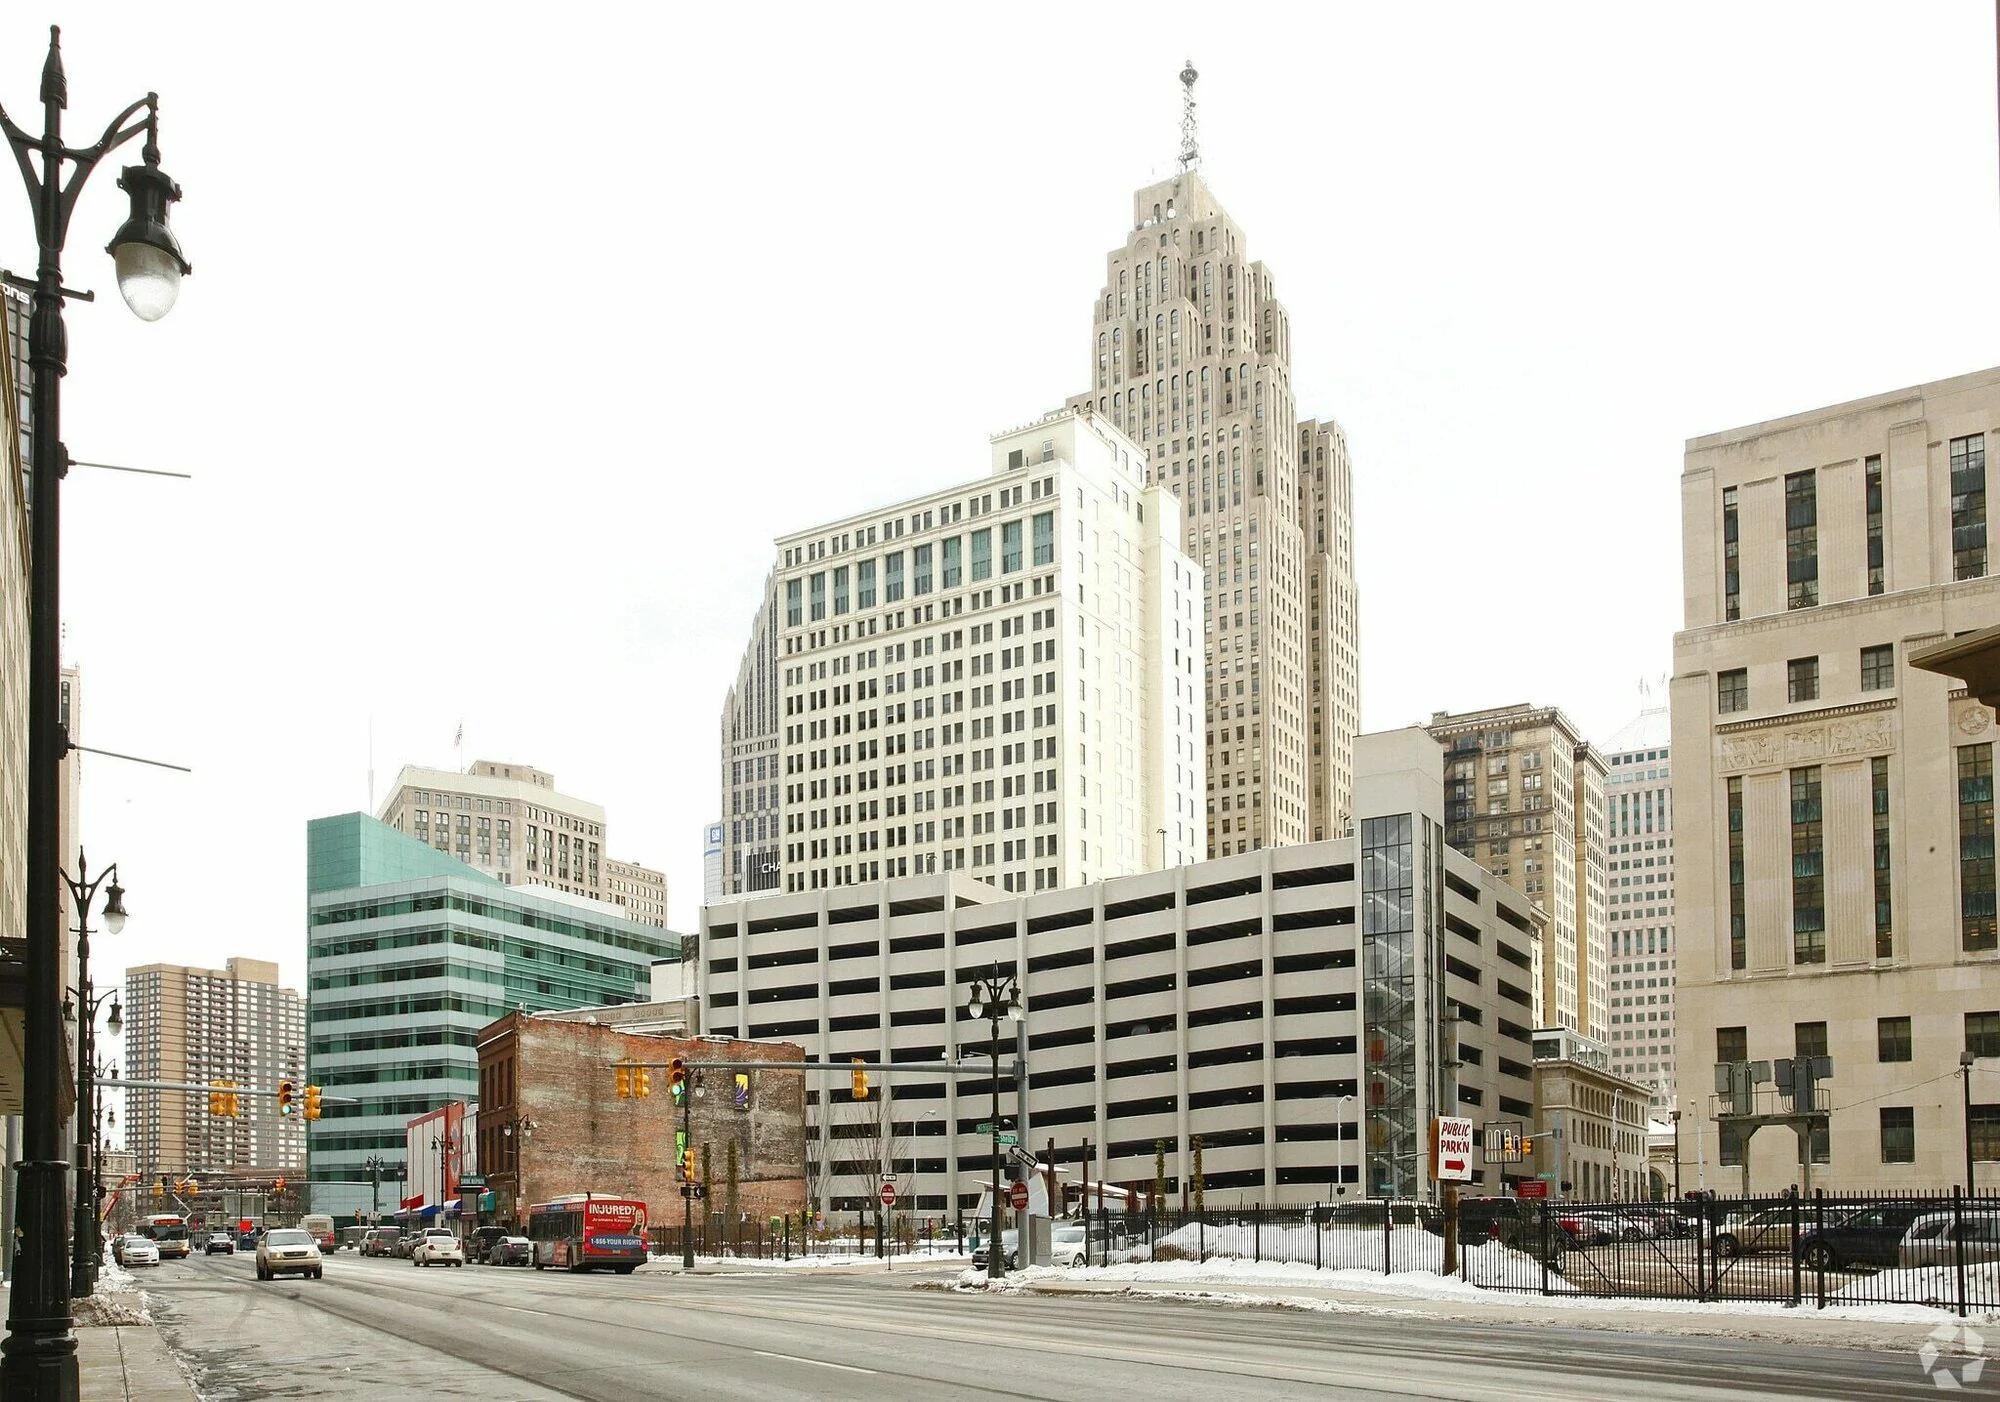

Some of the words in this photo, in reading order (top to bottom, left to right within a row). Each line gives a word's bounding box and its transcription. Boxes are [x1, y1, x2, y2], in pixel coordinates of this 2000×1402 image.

[711, 828, 720, 841] GM
[1441, 1121, 1471, 1137] PUBLIC
[589, 1203, 636, 1216] INJURED?
